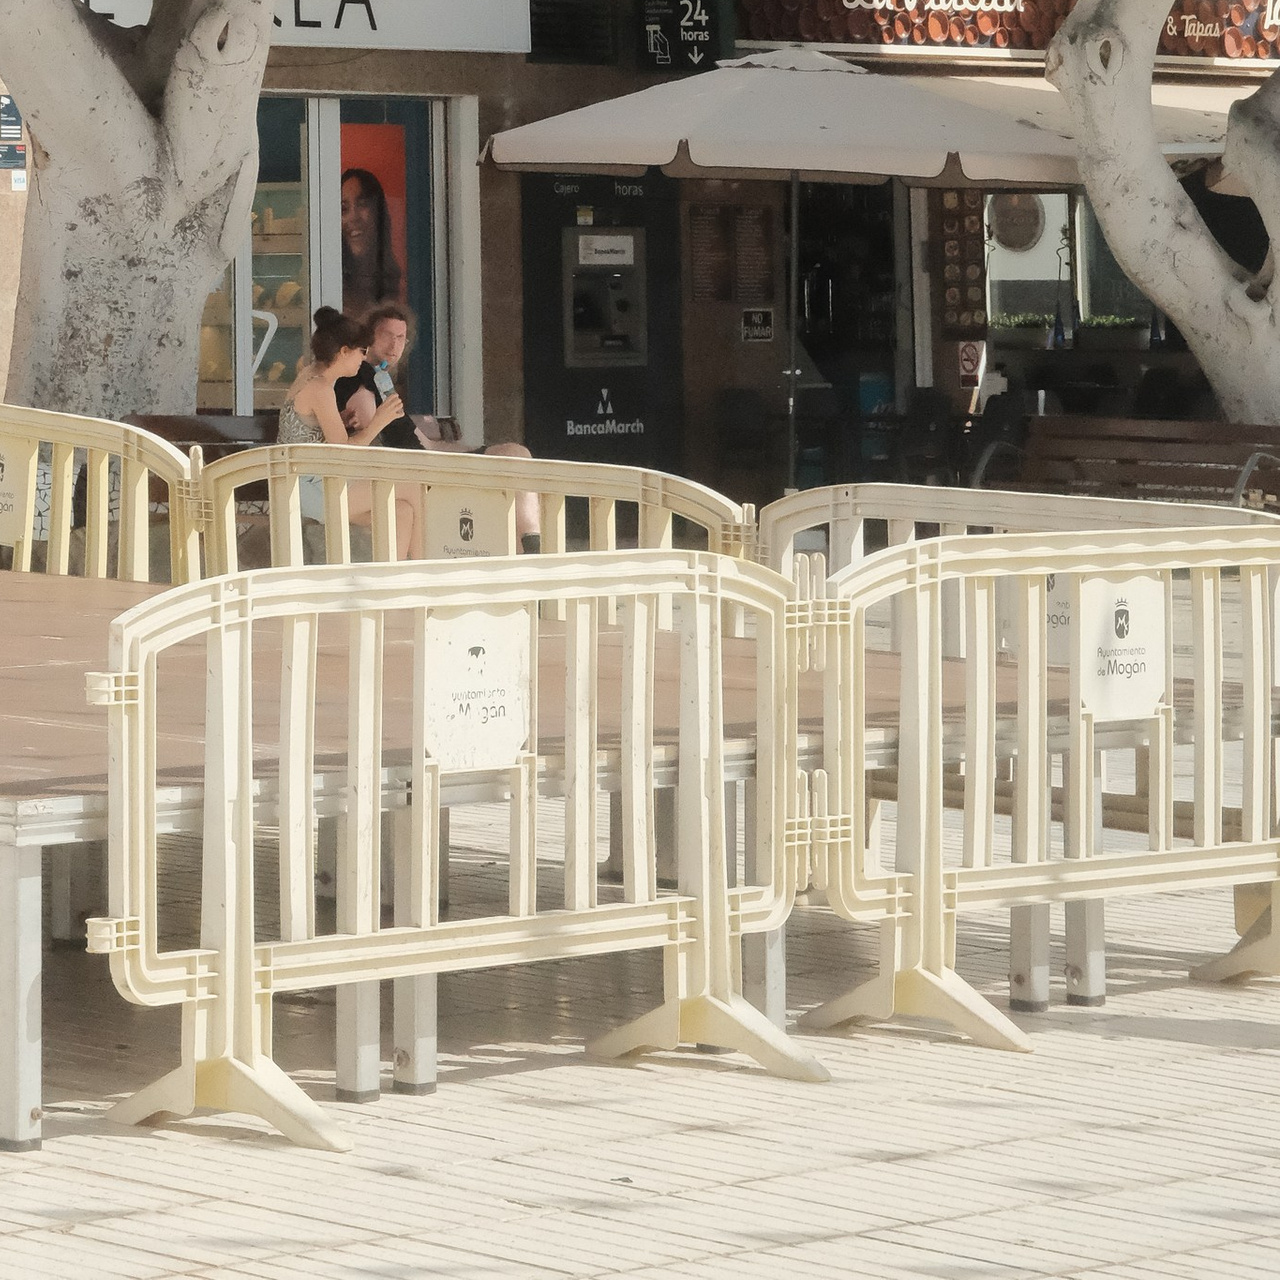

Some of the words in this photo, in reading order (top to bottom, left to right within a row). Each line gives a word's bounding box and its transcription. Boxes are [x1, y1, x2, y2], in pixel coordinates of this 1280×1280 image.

[679, 0, 709, 27] 24
[680, 28, 710, 42] horas
[1167, 15, 1178, 36] &
[1181, 14, 1220, 42] Tapas
[553, 181, 580, 196] Cajero
[614, 180, 644, 196] horas
[751, 313, 763, 324] NO
[744, 326, 772, 338] FUMAR
[566, 418, 645, 436] BancaMarch
[1097, 646, 1146, 660] Ayuntamiento
[1097, 666, 1106, 677] de
[1106, 658, 1147, 679] Mogán
